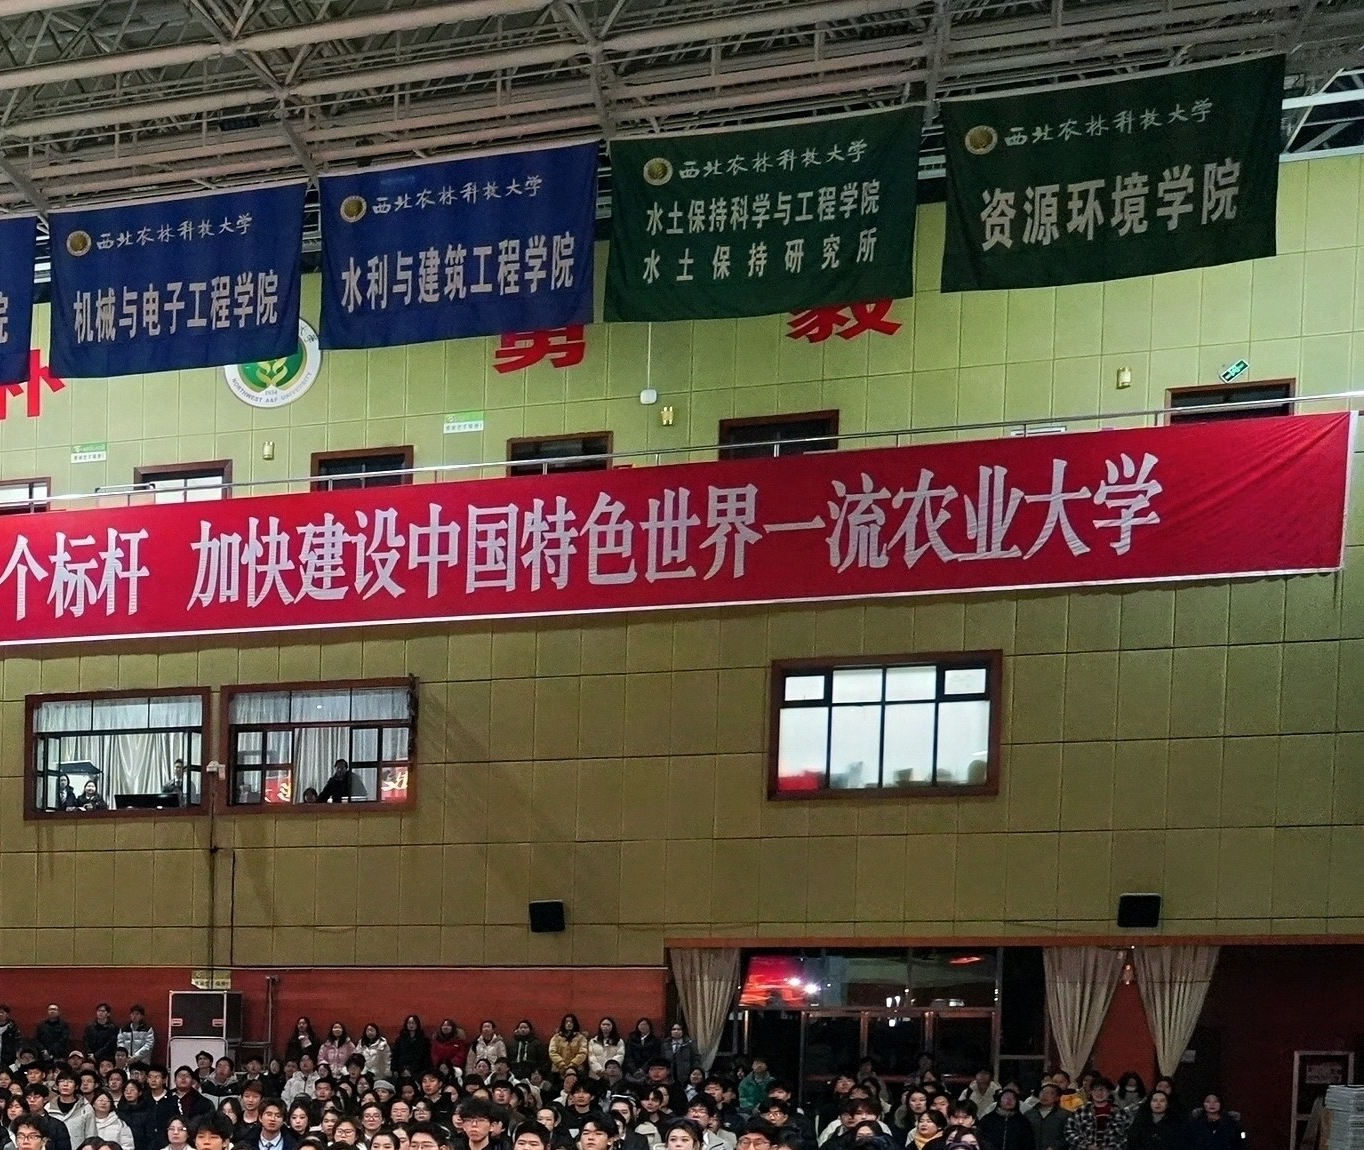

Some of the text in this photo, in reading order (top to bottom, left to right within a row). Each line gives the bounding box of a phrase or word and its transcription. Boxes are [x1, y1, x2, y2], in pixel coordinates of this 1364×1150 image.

[1004, 98, 1213, 148] 西北农林科技大学
[679, 140, 868, 180] 西北农林科技大学
[372, 175, 544, 216] 西北农林科技大学
[645, 179, 880, 236] 水土保持科学与工程学院
[979, 157, 1243, 252] 资源环境学院
[96, 212, 254, 250] 西北农林科技大学
[642, 228, 877, 284] 水土保持研究所
[340, 233, 575, 313] 水利与建筑工程学院
[73, 269, 279, 345] 机械与电子工程学院
[186, 453, 1165, 612] 加快建设中国特色世界一流农业大学
